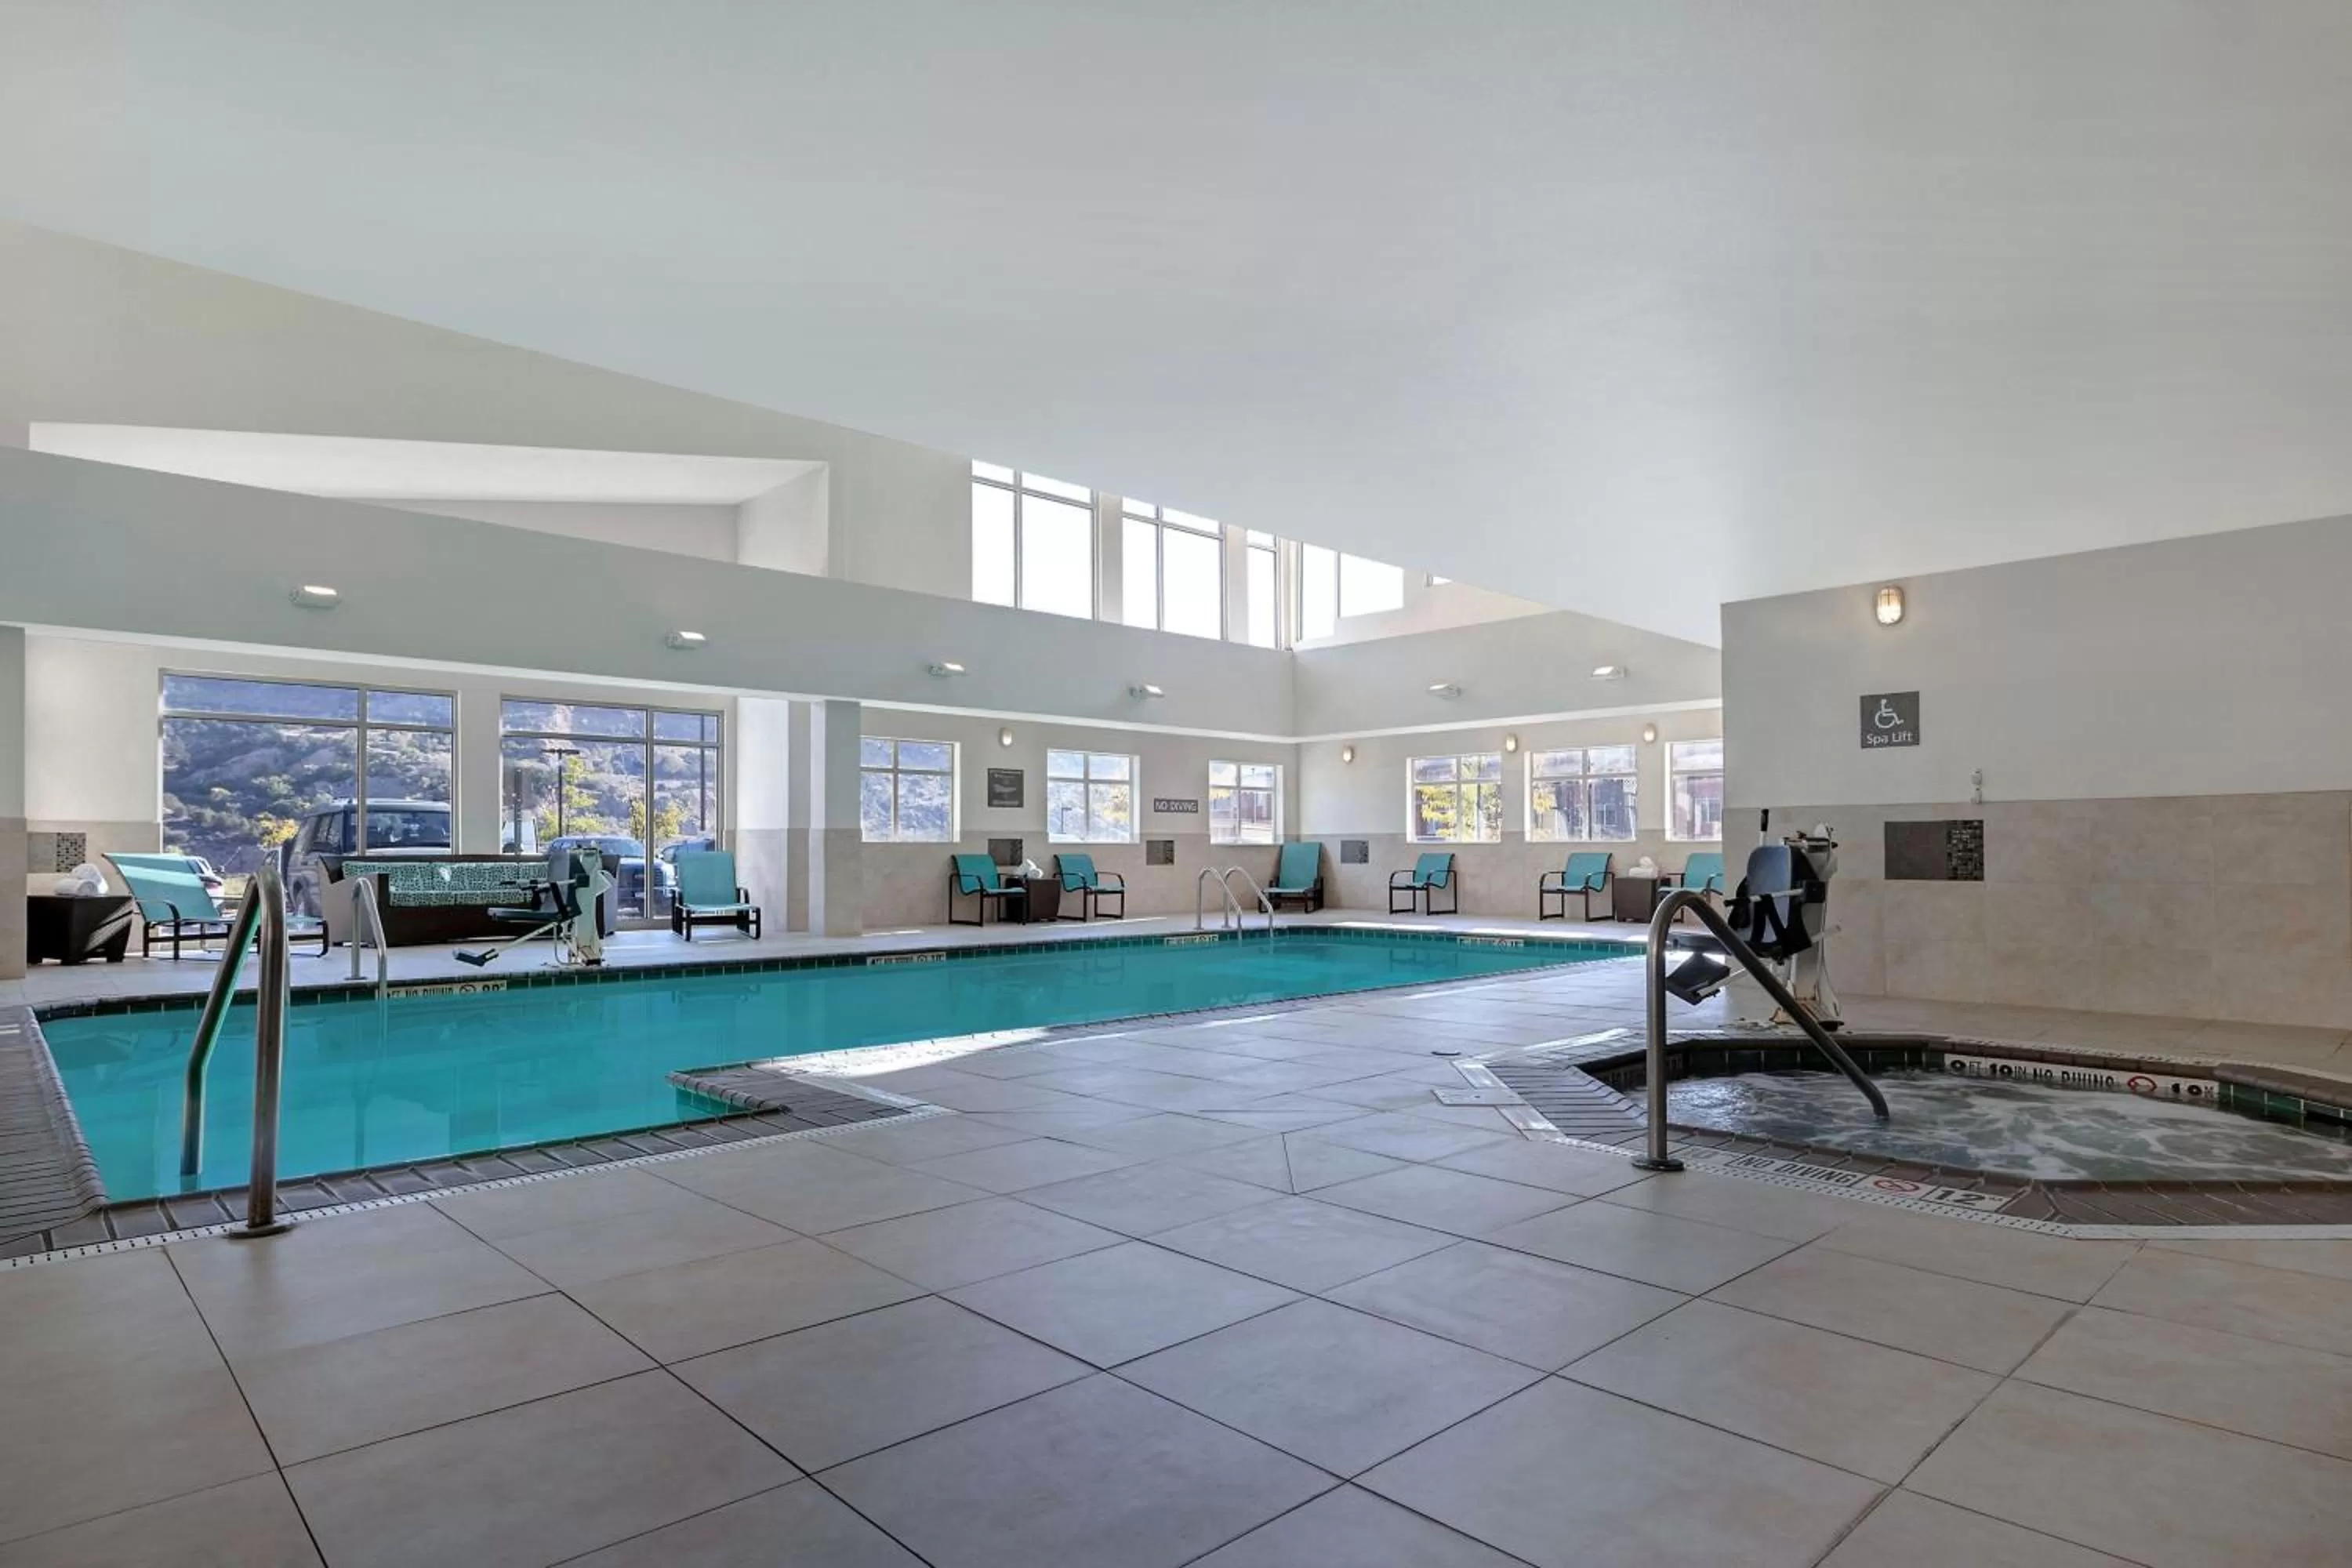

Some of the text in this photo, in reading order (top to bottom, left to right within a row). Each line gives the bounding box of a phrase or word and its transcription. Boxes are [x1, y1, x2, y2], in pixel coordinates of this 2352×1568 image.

[1867, 731, 1913, 746] Spa Lift
[1156, 800, 1196, 812] NO DIVING
[1737, 1156, 1775, 1168] NO
[1774, 1163, 1857, 1183] DIVING
